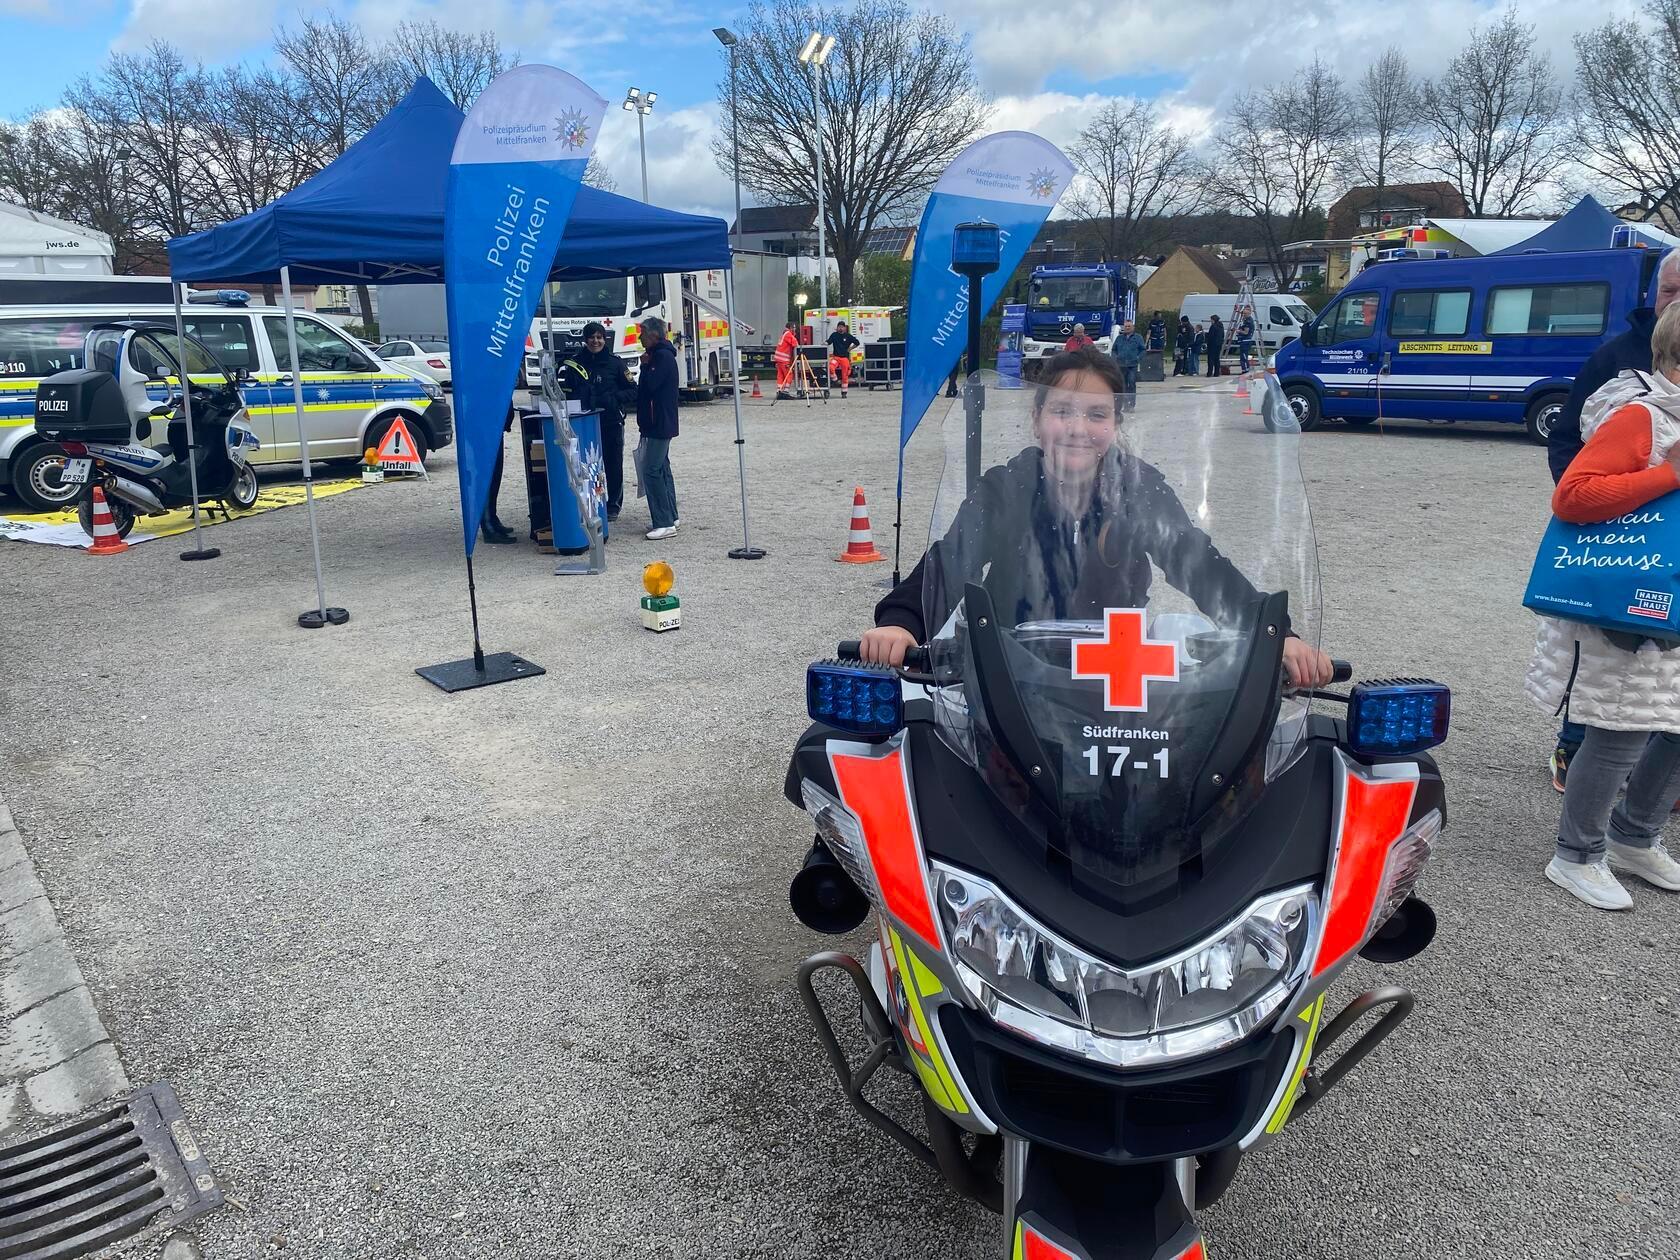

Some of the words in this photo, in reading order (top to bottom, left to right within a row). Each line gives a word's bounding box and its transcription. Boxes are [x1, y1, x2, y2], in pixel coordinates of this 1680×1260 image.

[483, 123, 546, 136] Polizeipräsidium
[496, 135, 547, 145] Mittelfranken
[966, 167, 1022, 181] Polizeipräsidium
[975, 178, 1020, 190] Mittelfranken
[487, 183, 526, 267] Polizei
[45, 240, 80, 250] jws.de
[486, 197, 550, 358] Mittelfranken
[931, 229, 1011, 347] Mittelfn
[1401, 343, 1443, 352] ABSCHNITTS
[1447, 344, 1479, 352] LEITUNG
[8, 362, 26, 373] 110
[1347, 367, 1369, 375] 21/10
[38, 400, 69, 412] POLIZEI
[117, 445, 146, 456] POLIZEI
[383, 461, 411, 470] Unfall
[72, 474, 85, 482] 528
[1577, 526, 1647, 545] mein
[1553, 546, 1673, 570] Zuhause.
[1534, 594, 1593, 608] www.hanse-haus.de
[1639, 591, 1669, 602] HANSE
[1643, 601, 1668, 611] HAUS
[658, 618, 680, 628] POLZEI
[1082, 725, 1170, 741] Südfranken
[1082, 745, 1169, 779] 17-1
